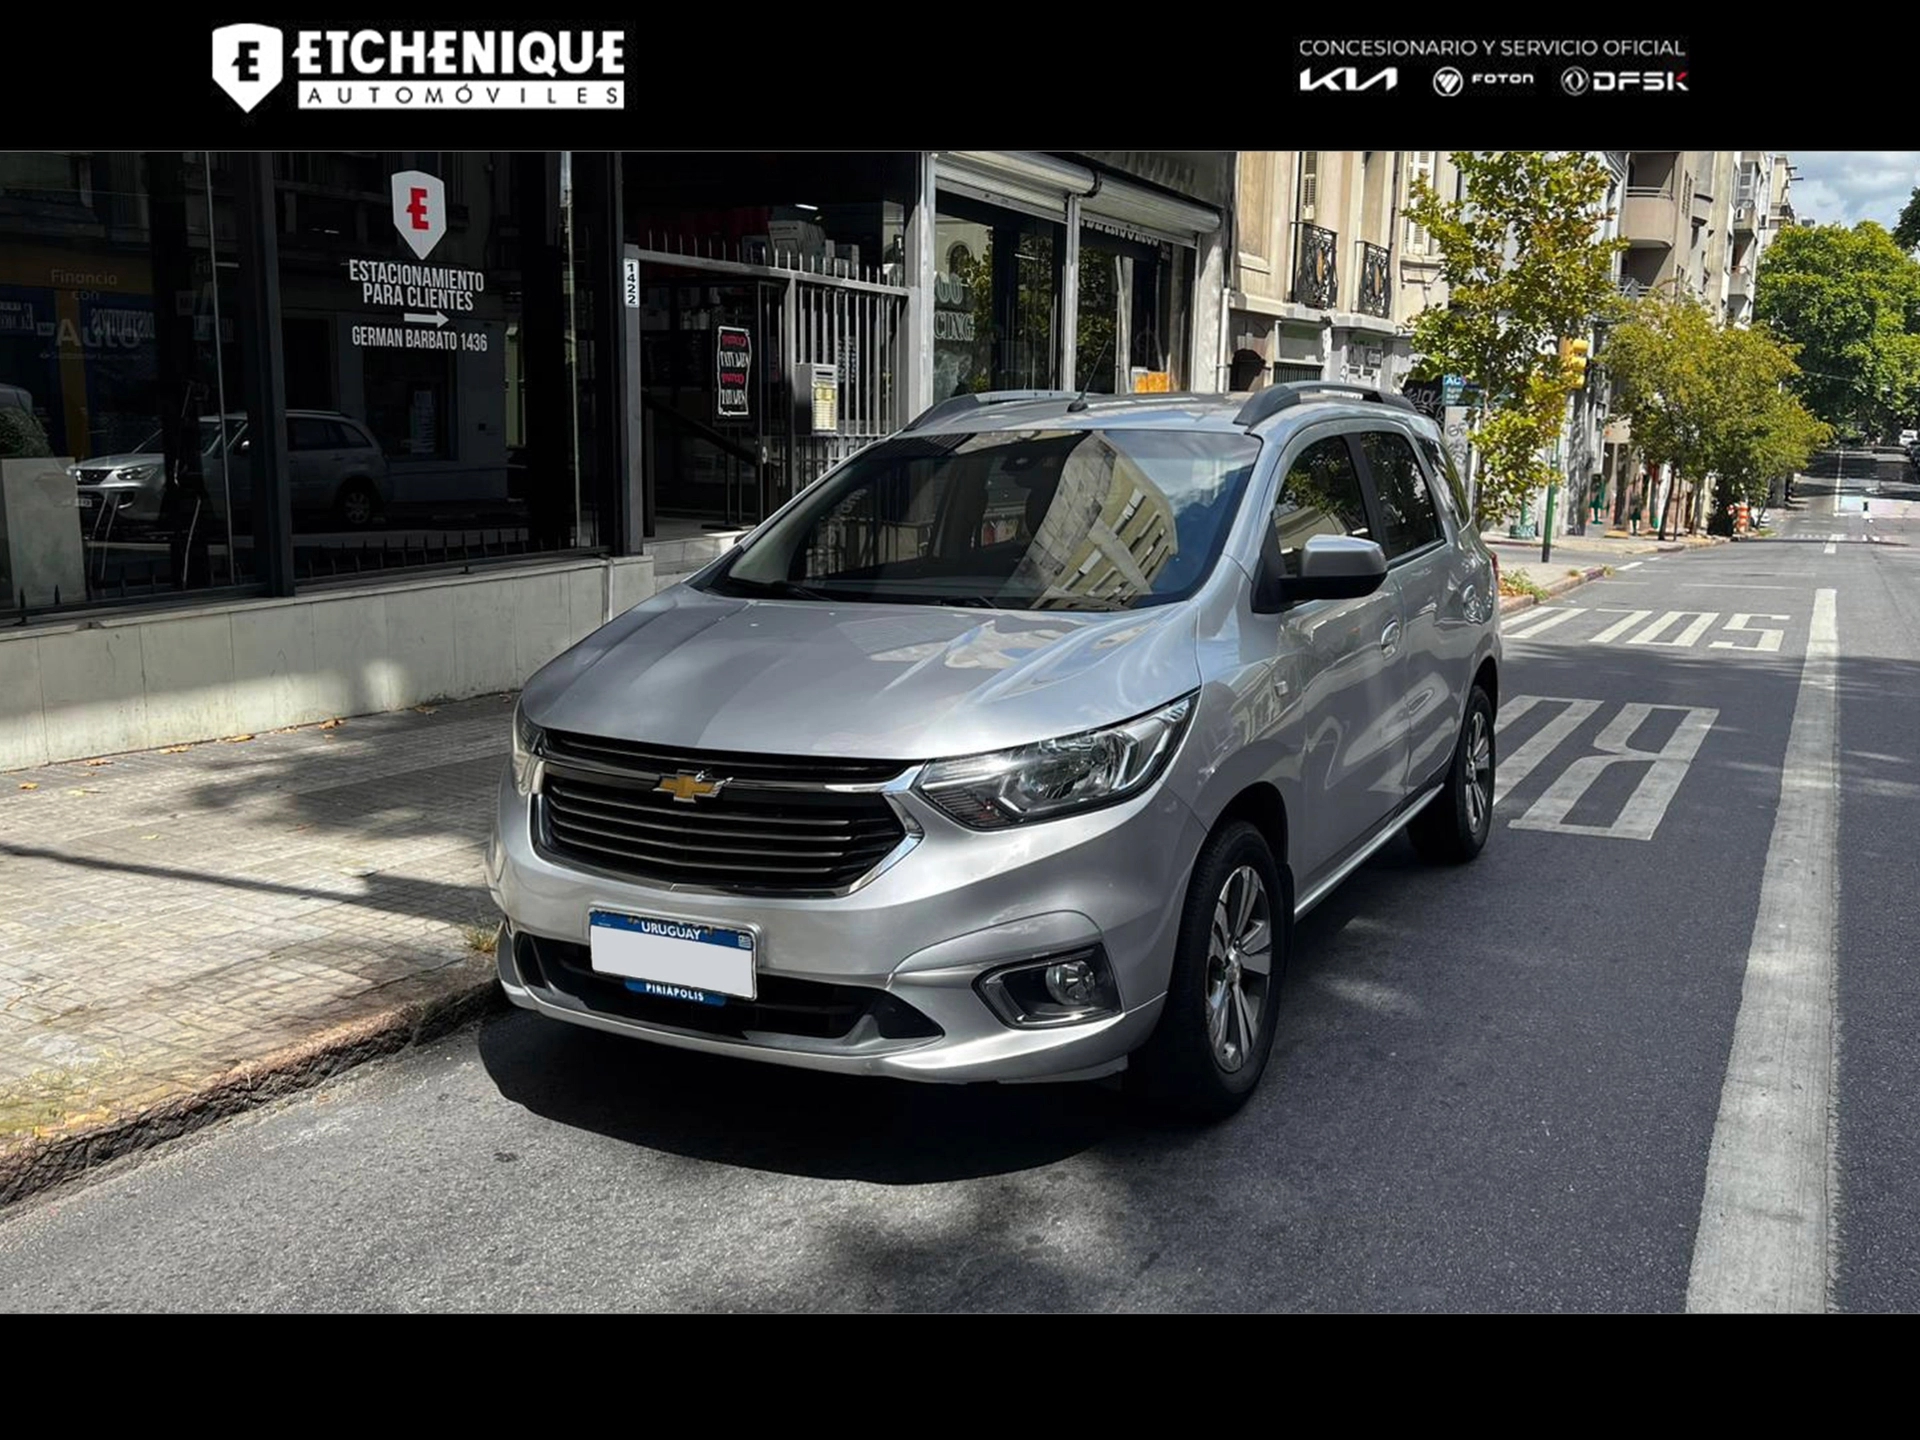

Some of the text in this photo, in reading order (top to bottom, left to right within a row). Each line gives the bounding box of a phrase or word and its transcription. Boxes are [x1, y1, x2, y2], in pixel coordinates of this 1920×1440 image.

[51, 268, 118, 286] Financia
[349, 259, 485, 292] ESTACIONAMIENTO
[627, 263, 636, 304] 1422
[363, 282, 474, 311] PARA CLIENTES
[54, 318, 141, 349] Auto
[352, 326, 488, 351] GERMAN BARBATO 1436
[641, 921, 701, 941] URUGUAY
